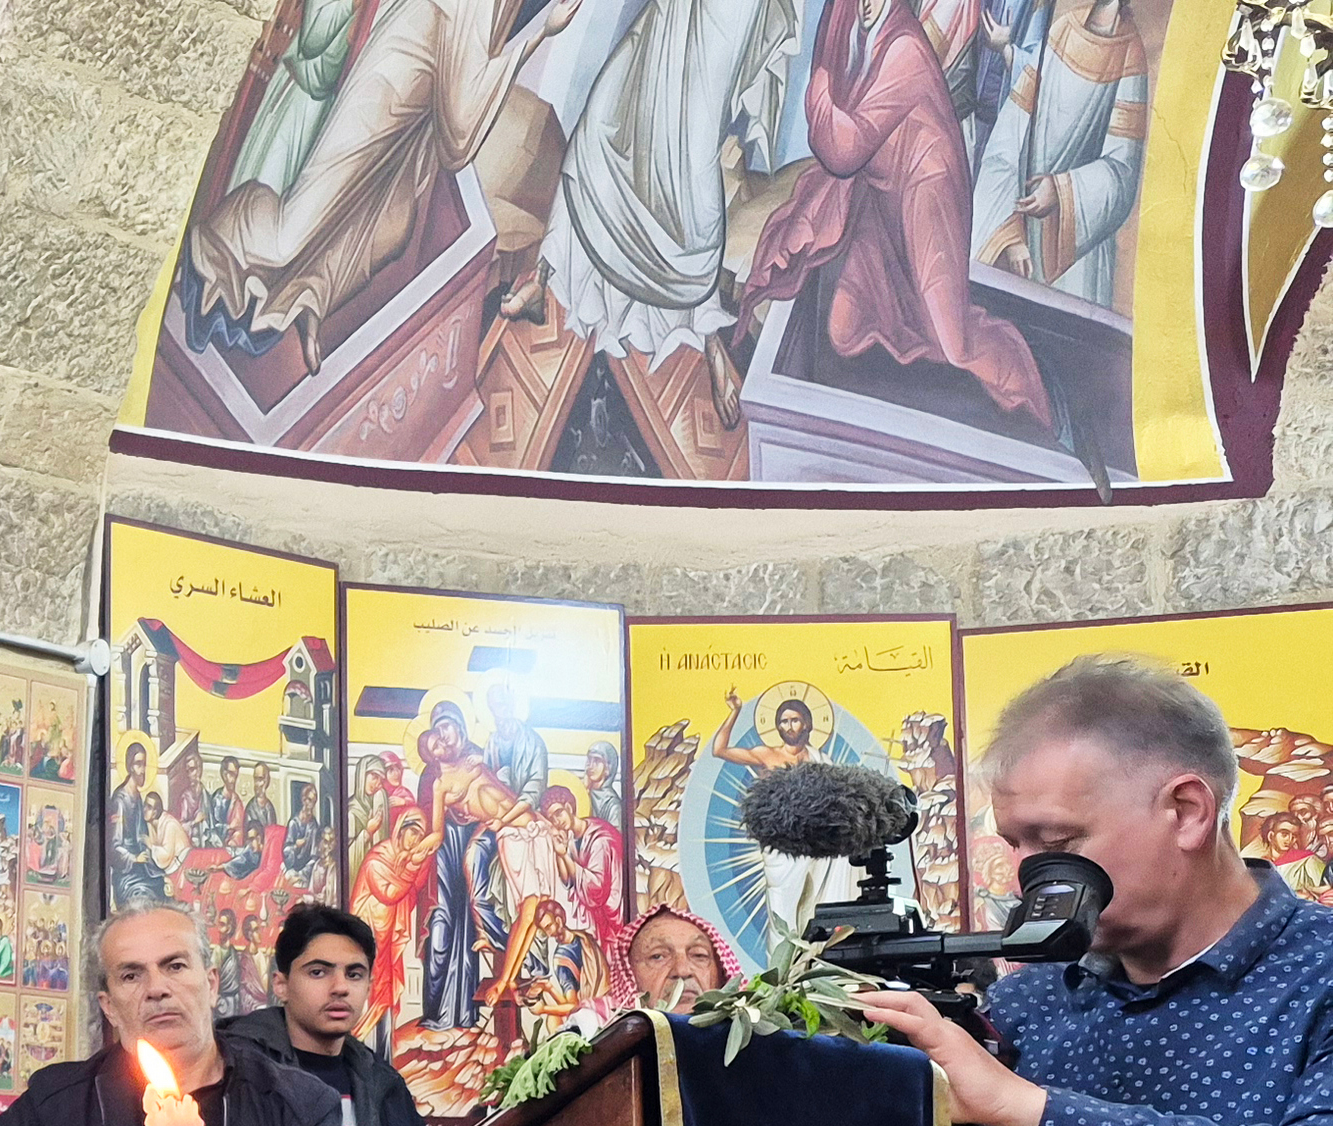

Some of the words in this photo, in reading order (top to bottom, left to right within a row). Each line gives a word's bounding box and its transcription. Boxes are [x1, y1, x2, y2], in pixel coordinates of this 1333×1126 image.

[169, 575, 225, 599] السري
[229, 580, 282, 608] العشاء
[413, 618, 459, 634] الصليب
[462, 621, 479, 636] عن
